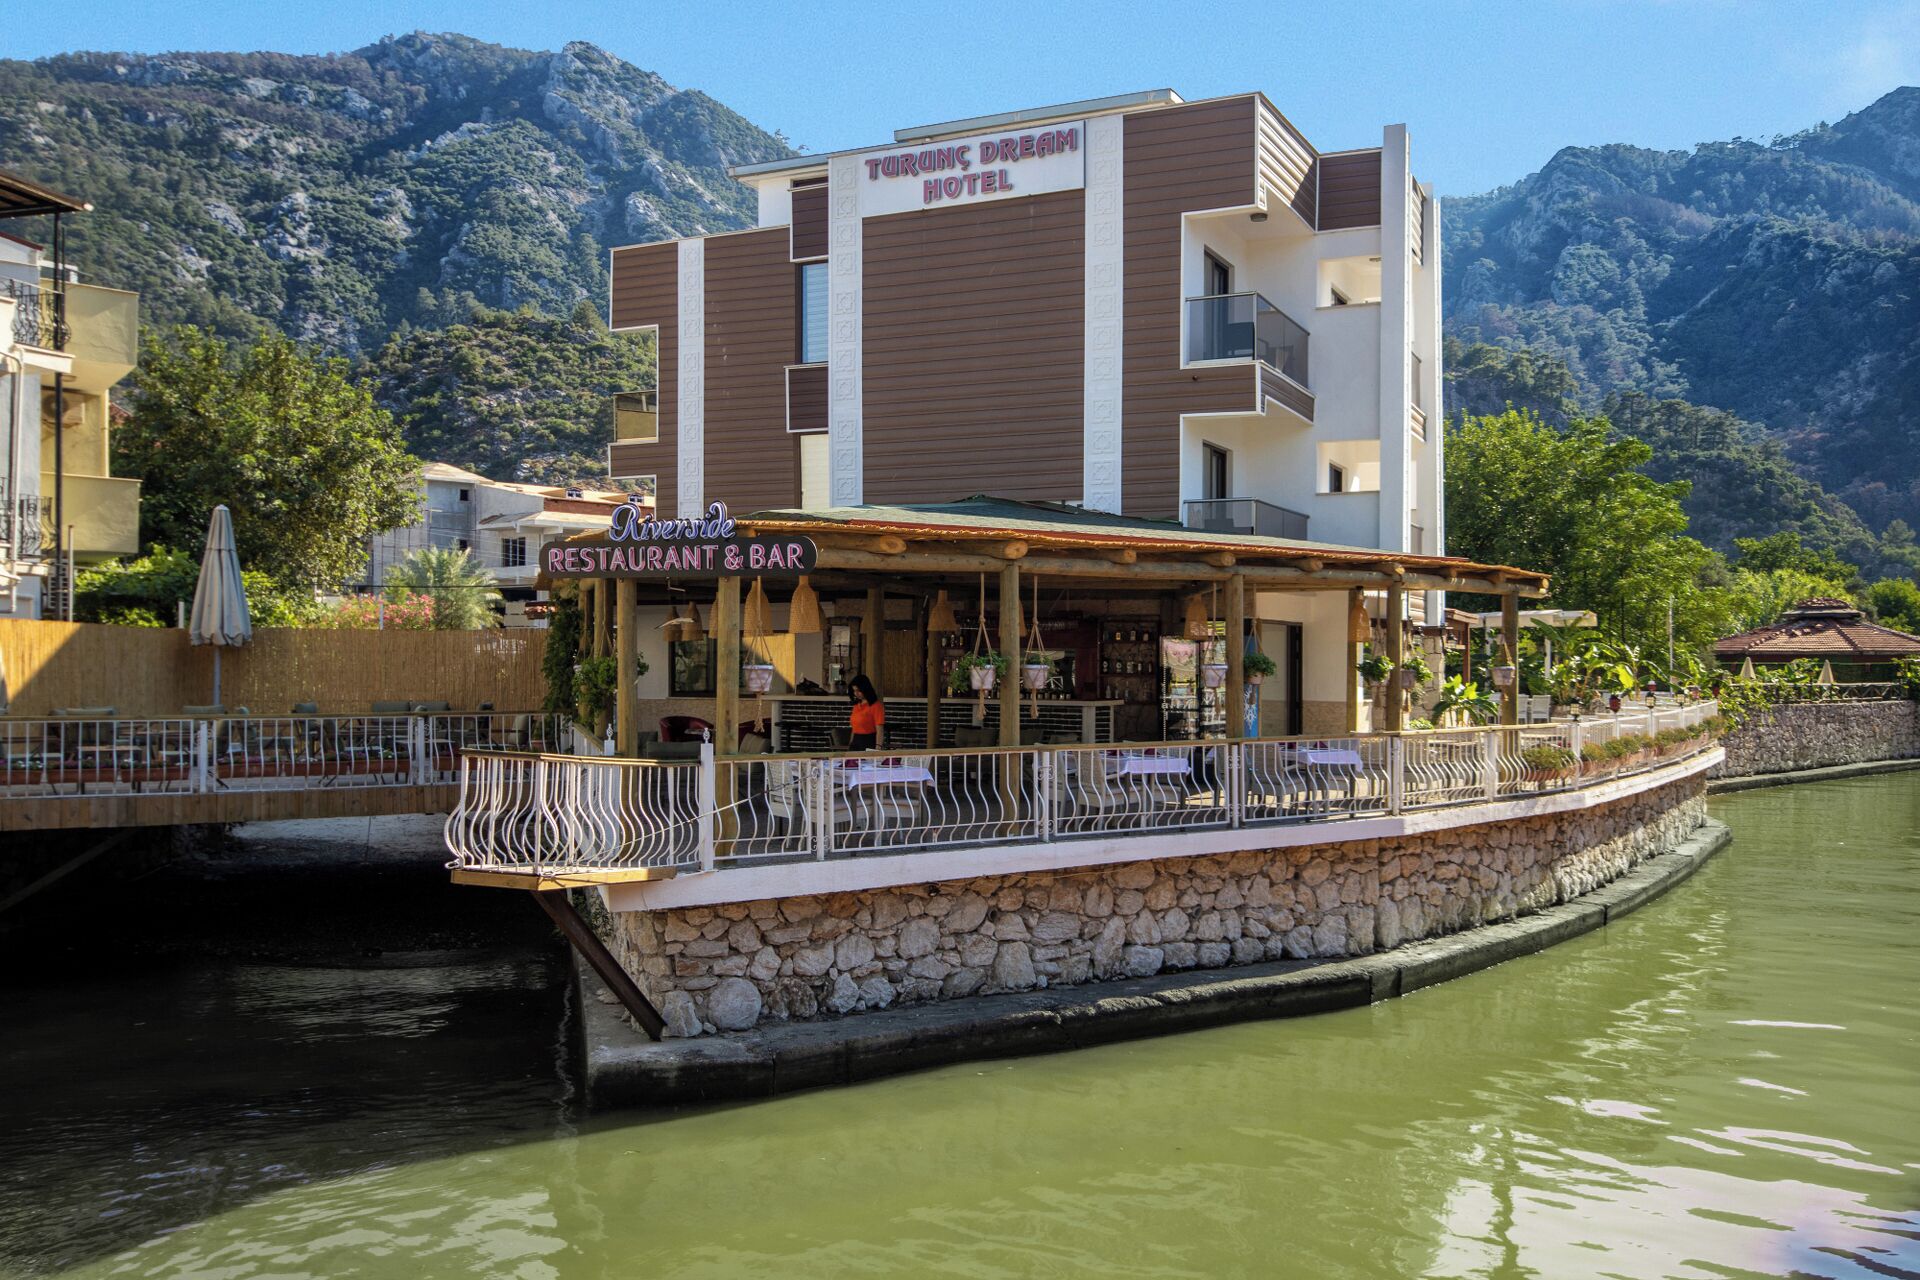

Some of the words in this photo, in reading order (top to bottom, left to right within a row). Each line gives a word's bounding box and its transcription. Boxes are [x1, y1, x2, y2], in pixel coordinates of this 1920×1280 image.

[865, 144, 970, 181] TURUNÇ
[979, 128, 1077, 165] DREAM
[923, 169, 1012, 204] HOTEL
[608, 501, 737, 542] Riverside
[548, 544, 719, 573] RESTAURANT
[724, 544, 744, 571] &
[750, 542, 805, 570] BAR
